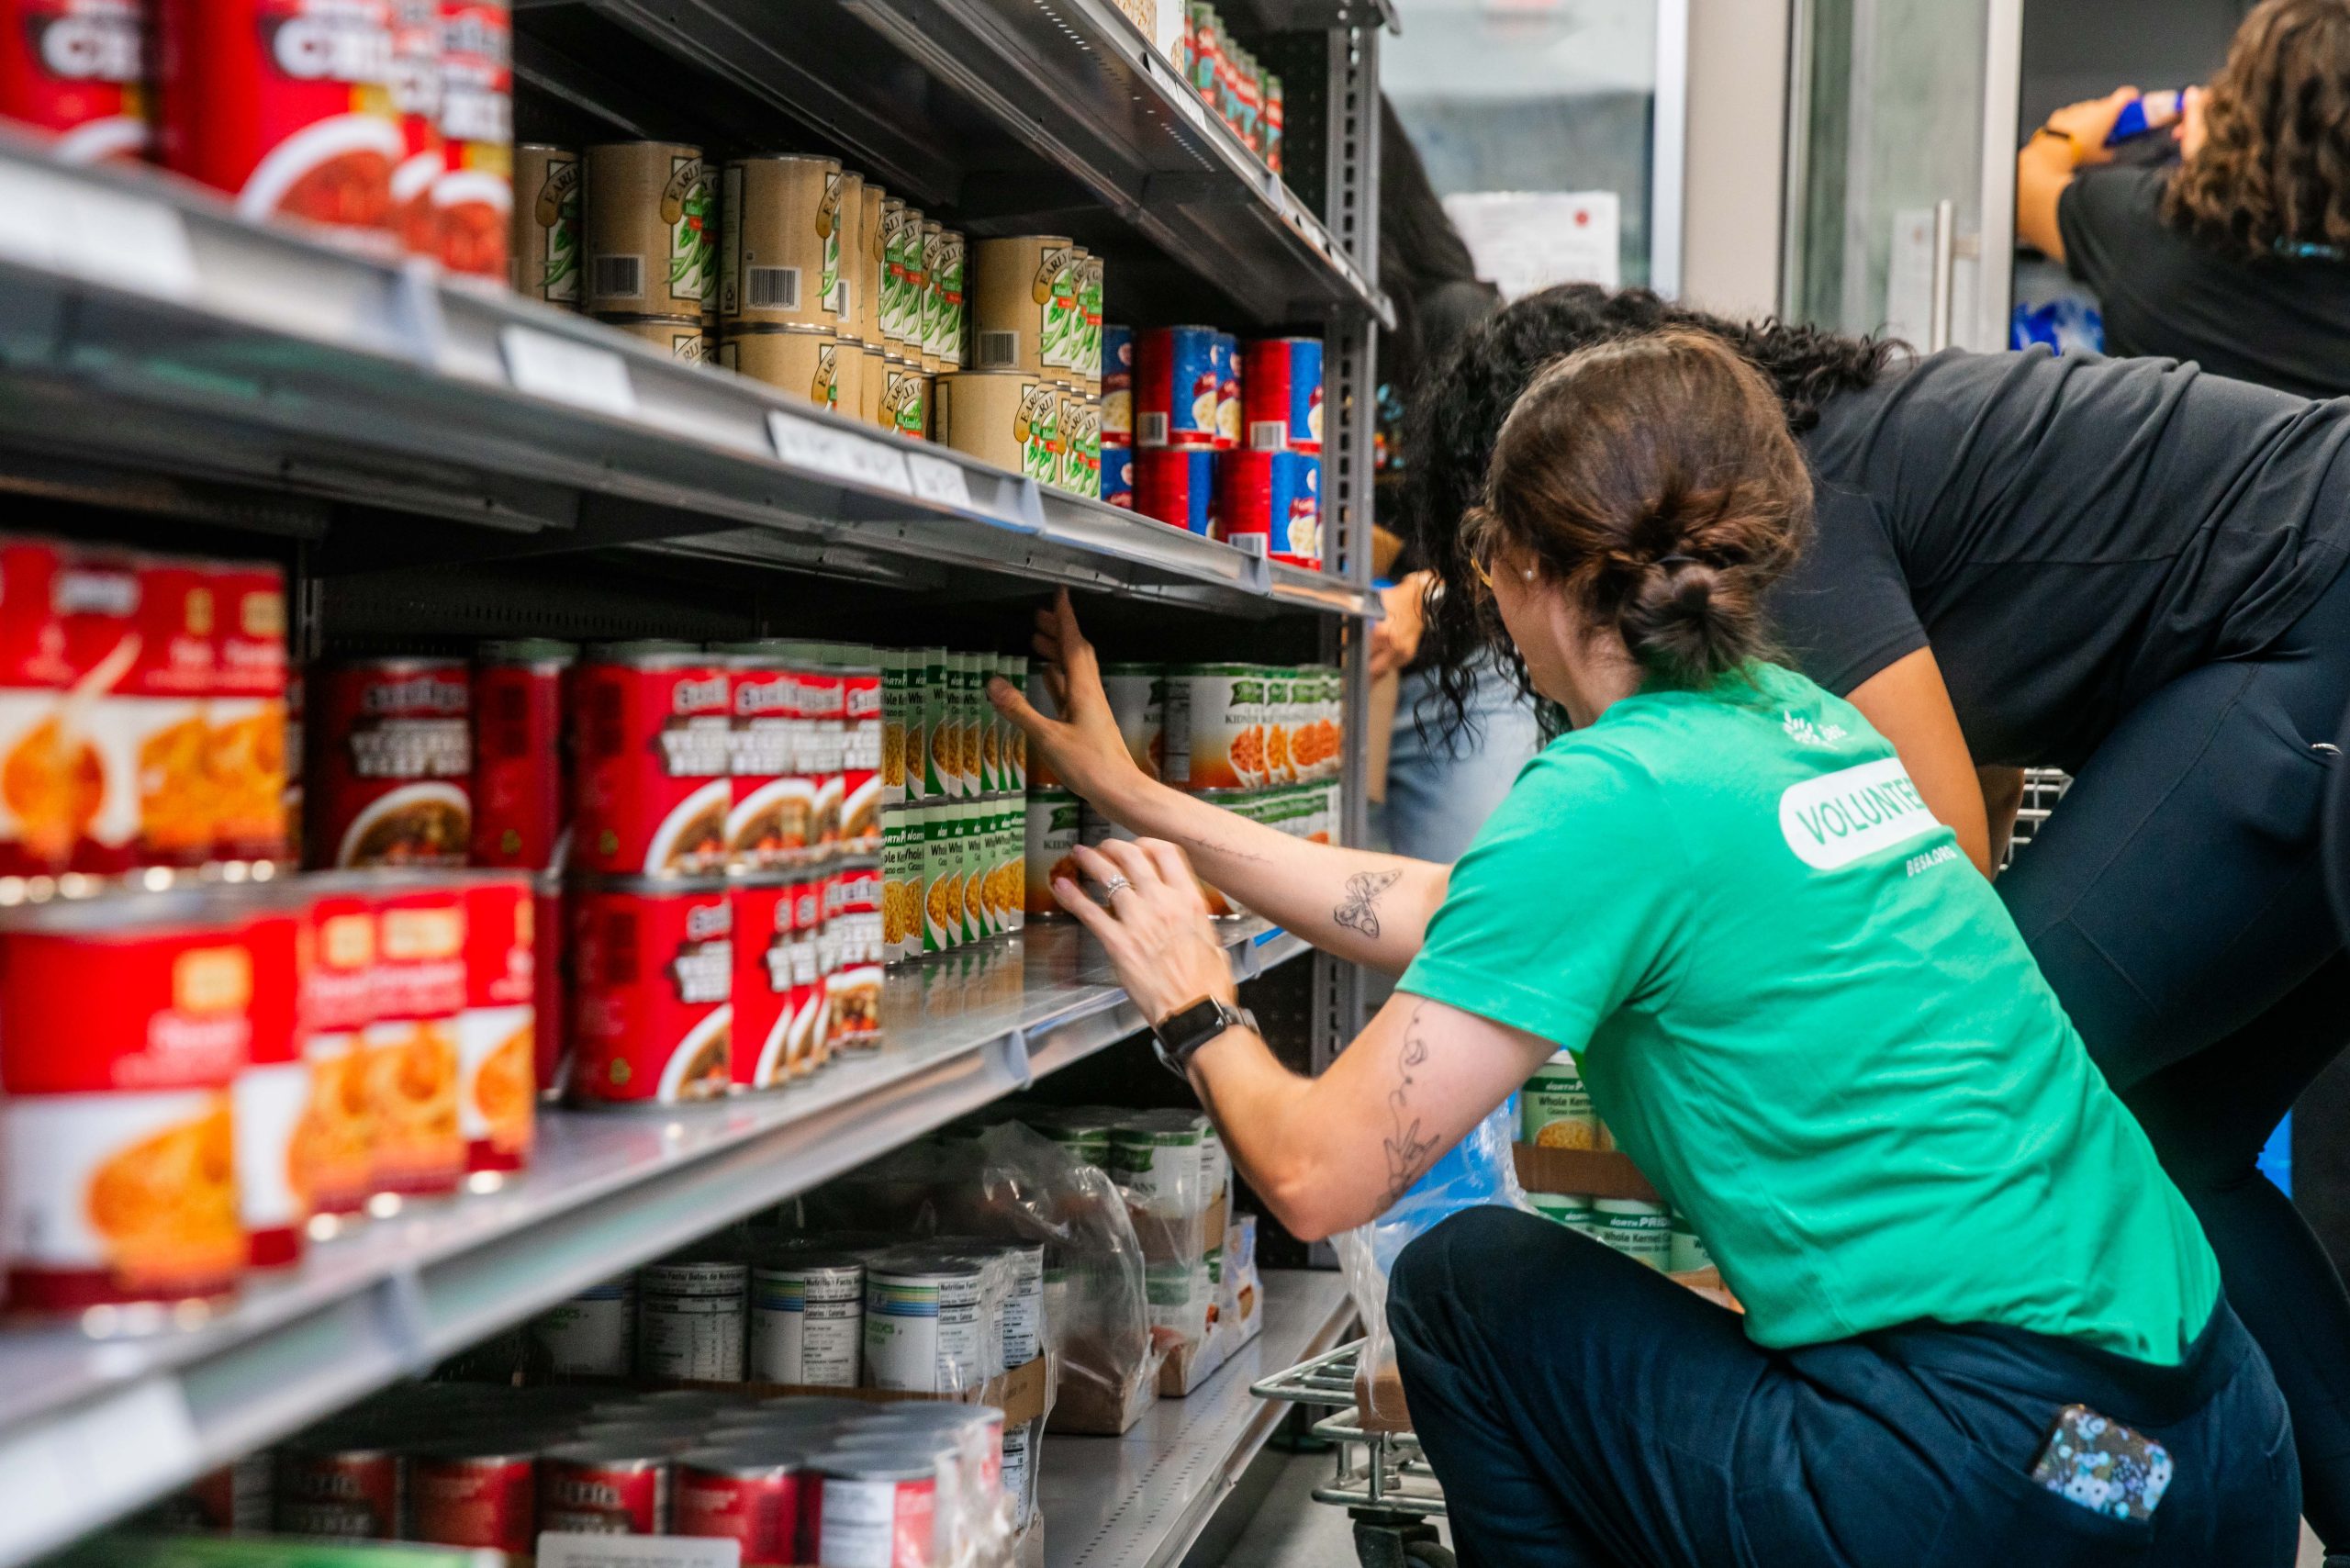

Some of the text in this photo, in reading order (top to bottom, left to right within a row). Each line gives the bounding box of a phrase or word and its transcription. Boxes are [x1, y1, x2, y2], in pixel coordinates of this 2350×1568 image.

[1796, 778, 1926, 846] VOLUNTE
[1906, 845, 1957, 878] BESA.ORG
[1539, 1095, 1593, 1107] Whole Kern
